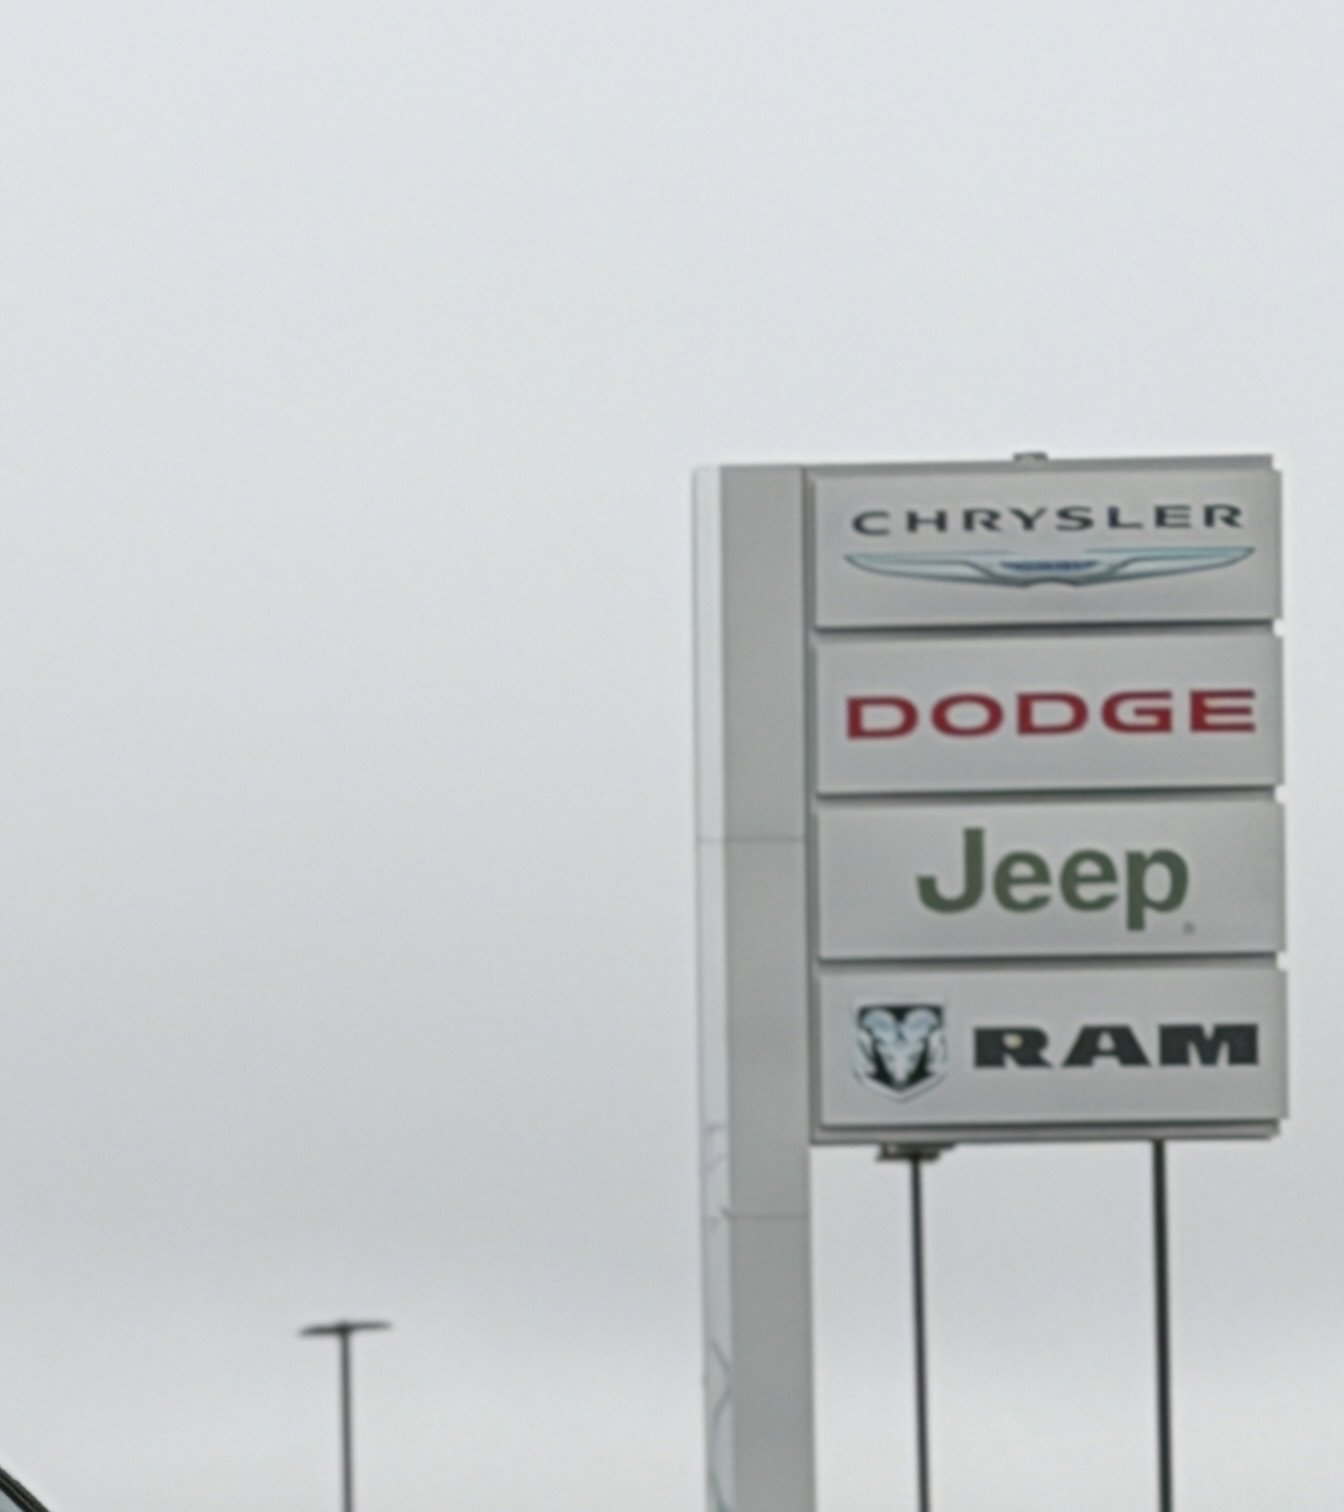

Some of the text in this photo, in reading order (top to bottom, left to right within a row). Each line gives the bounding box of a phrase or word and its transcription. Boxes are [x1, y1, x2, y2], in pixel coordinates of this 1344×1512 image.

[852, 504, 1244, 536] CHRYSLER
[846, 689, 1257, 740] DODGE
[916, 828, 1190, 932] Jeep
[973, 1023, 1259, 1069] RAM
